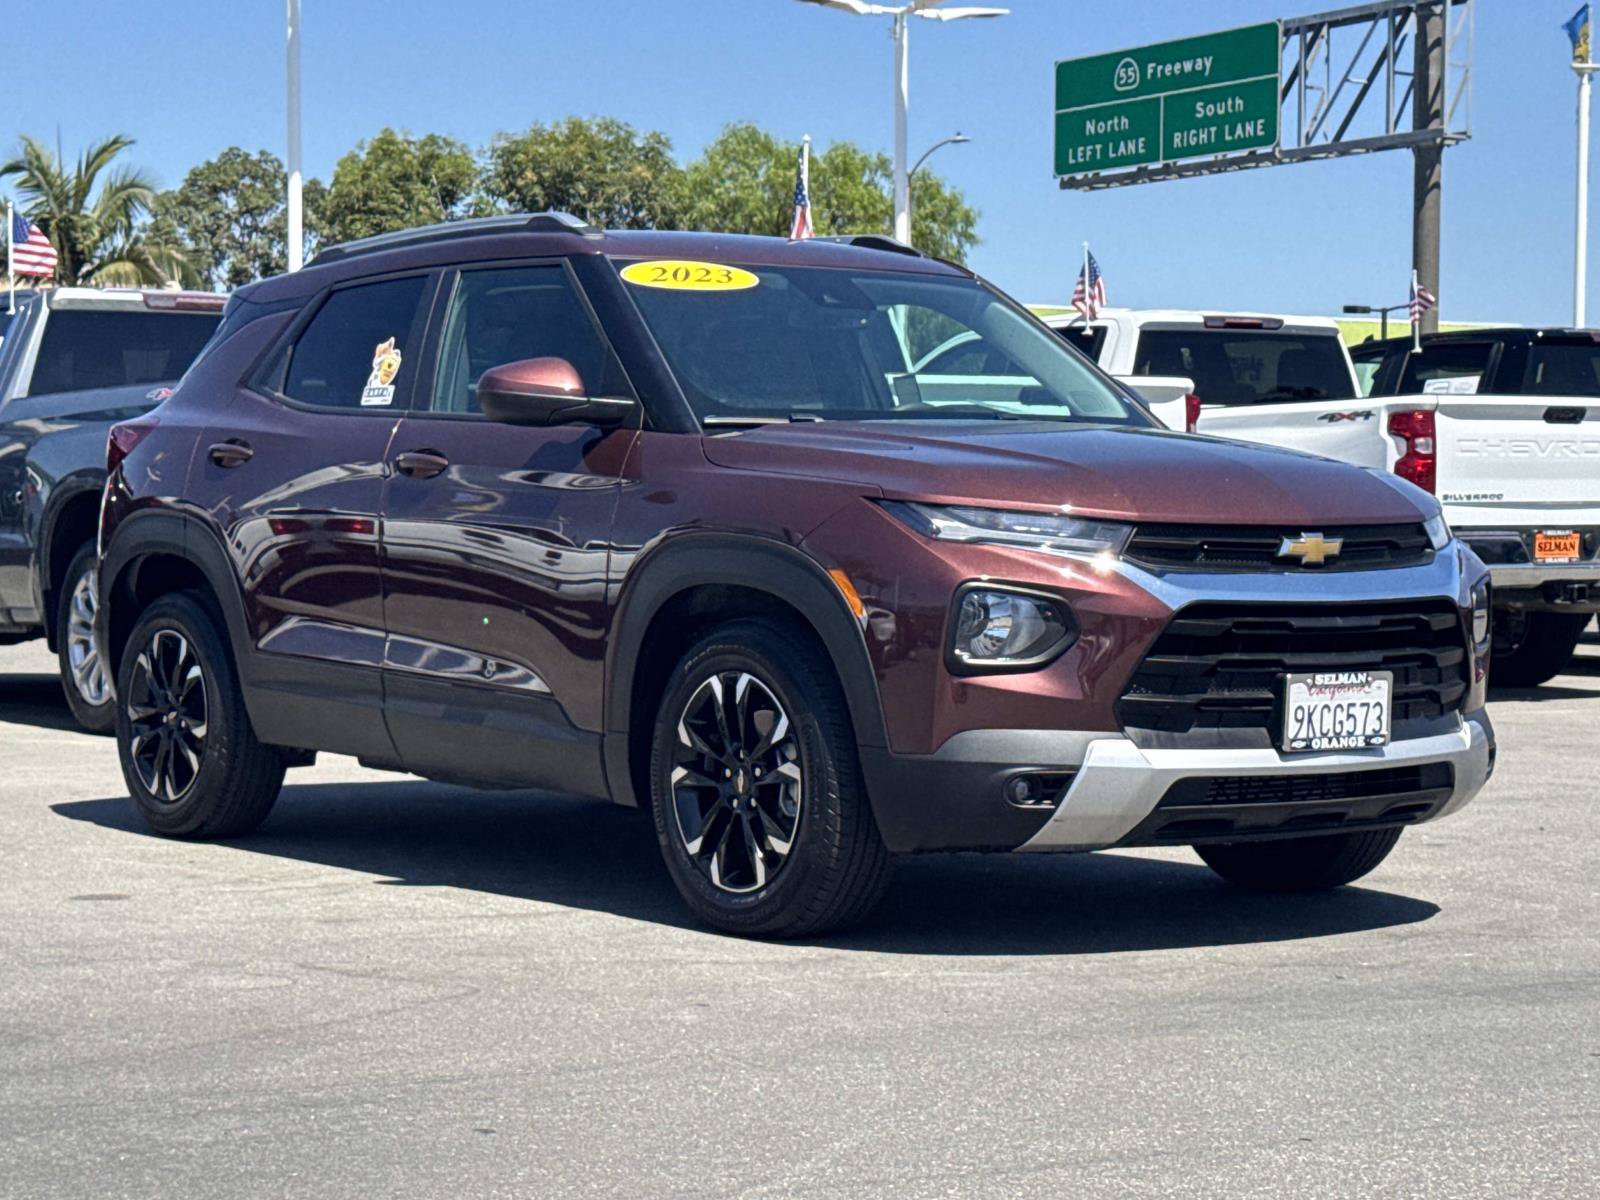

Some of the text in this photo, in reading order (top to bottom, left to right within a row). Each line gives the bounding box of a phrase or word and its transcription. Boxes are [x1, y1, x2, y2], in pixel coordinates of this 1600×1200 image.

[1119, 56, 1214, 83] 55 Freeway
[1195, 96, 1244, 118] South
[1085, 116, 1130, 136] North
[1173, 119, 1266, 149] RIGHT LANE
[1068, 137, 1147, 164] LEFT LANE
[651, 267, 733, 283] 2023
[1538, 541, 1576, 552] SELMAN
[1314, 672, 1367, 685] SELMAN
[1293, 701, 1383, 739] 9KCG573
[1311, 736, 1366, 749] ORANGE
